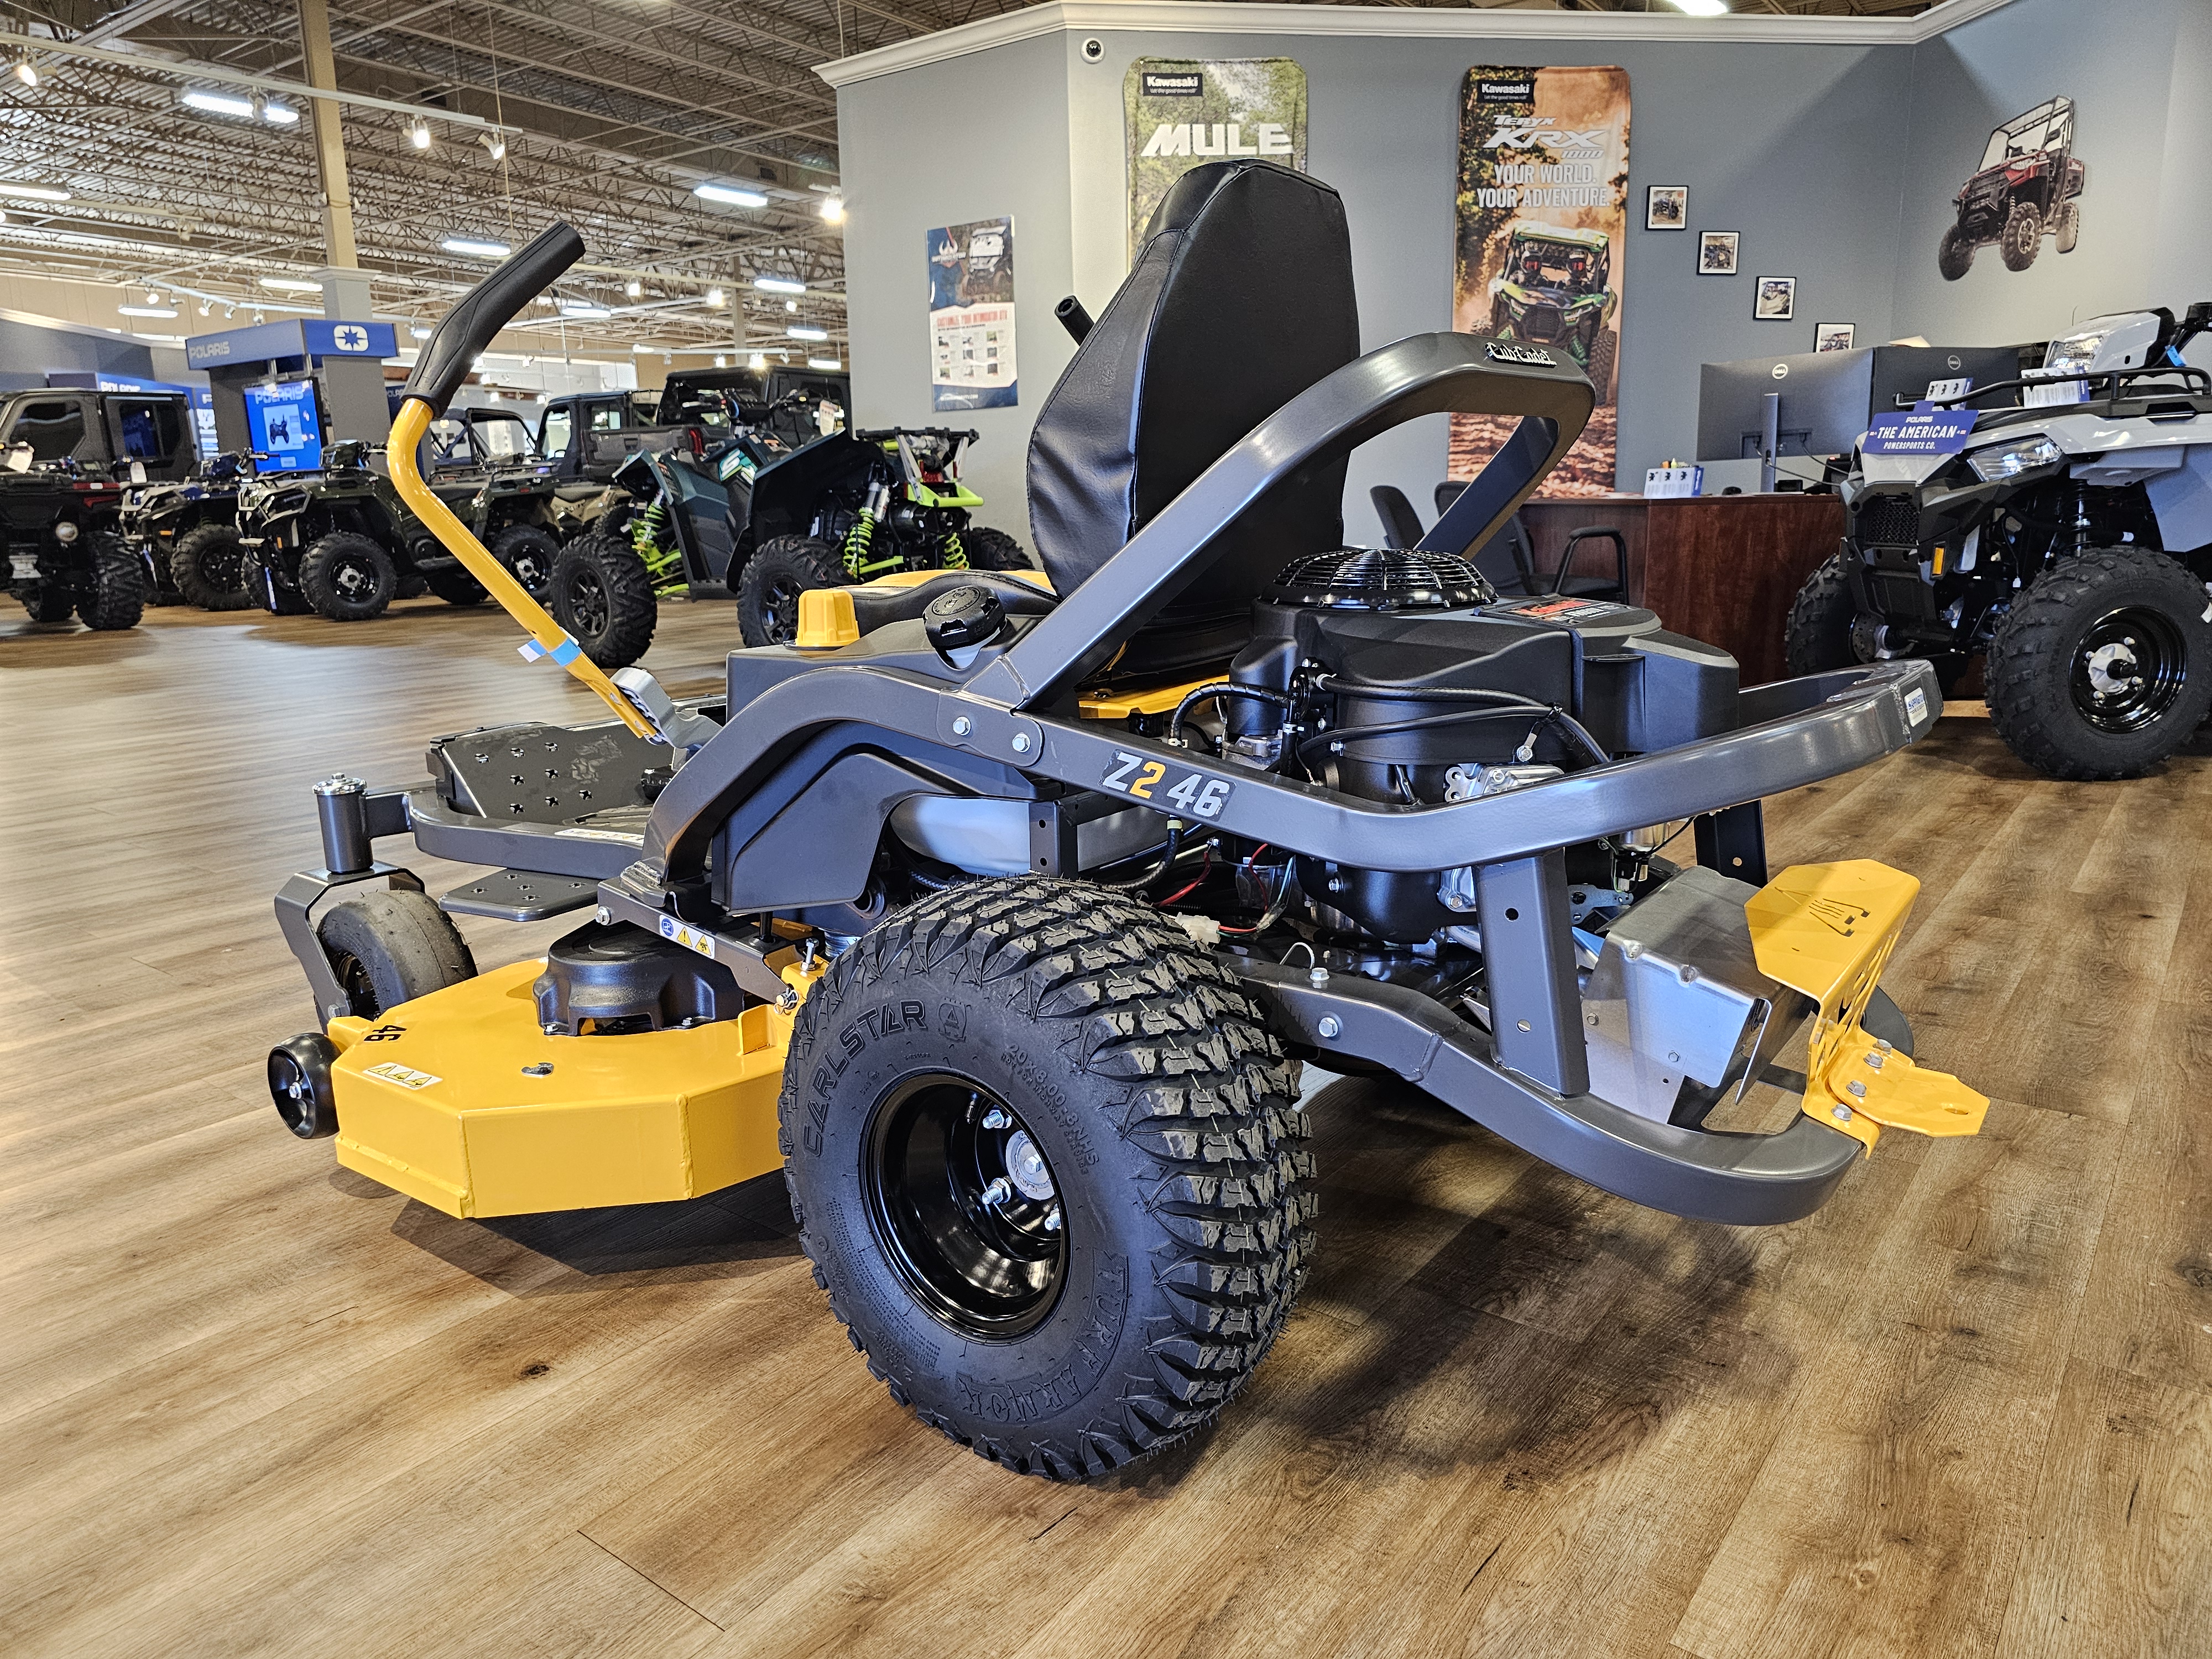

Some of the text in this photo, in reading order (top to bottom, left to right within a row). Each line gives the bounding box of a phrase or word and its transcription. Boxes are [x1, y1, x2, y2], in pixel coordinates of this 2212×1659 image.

[1146, 76, 1198, 87] Kawasaki
[1481, 84, 1530, 93] Kawasaki
[1140, 123, 1294, 157] MULE
[1483, 127, 1605, 148] KRX
[1561, 150, 1605, 159] 1000
[1494, 164, 1597, 184] YOUR WORLD.
[1477, 188, 1610, 207] YOUR ADVENTURE.
[189, 341, 231, 359] POLARIS
[1877, 425, 1958, 439] THE AMERICAN
[1925, 441, 1936, 450] CO.
[1102, 752, 1230, 817] Z2 46
[363, 1025, 408, 1041] 46
[804, 999, 928, 1157] CARLSTAR
[1063, 1130, 1089, 1175] SERVICE
[958, 1364, 1082, 1422] ARMOR
